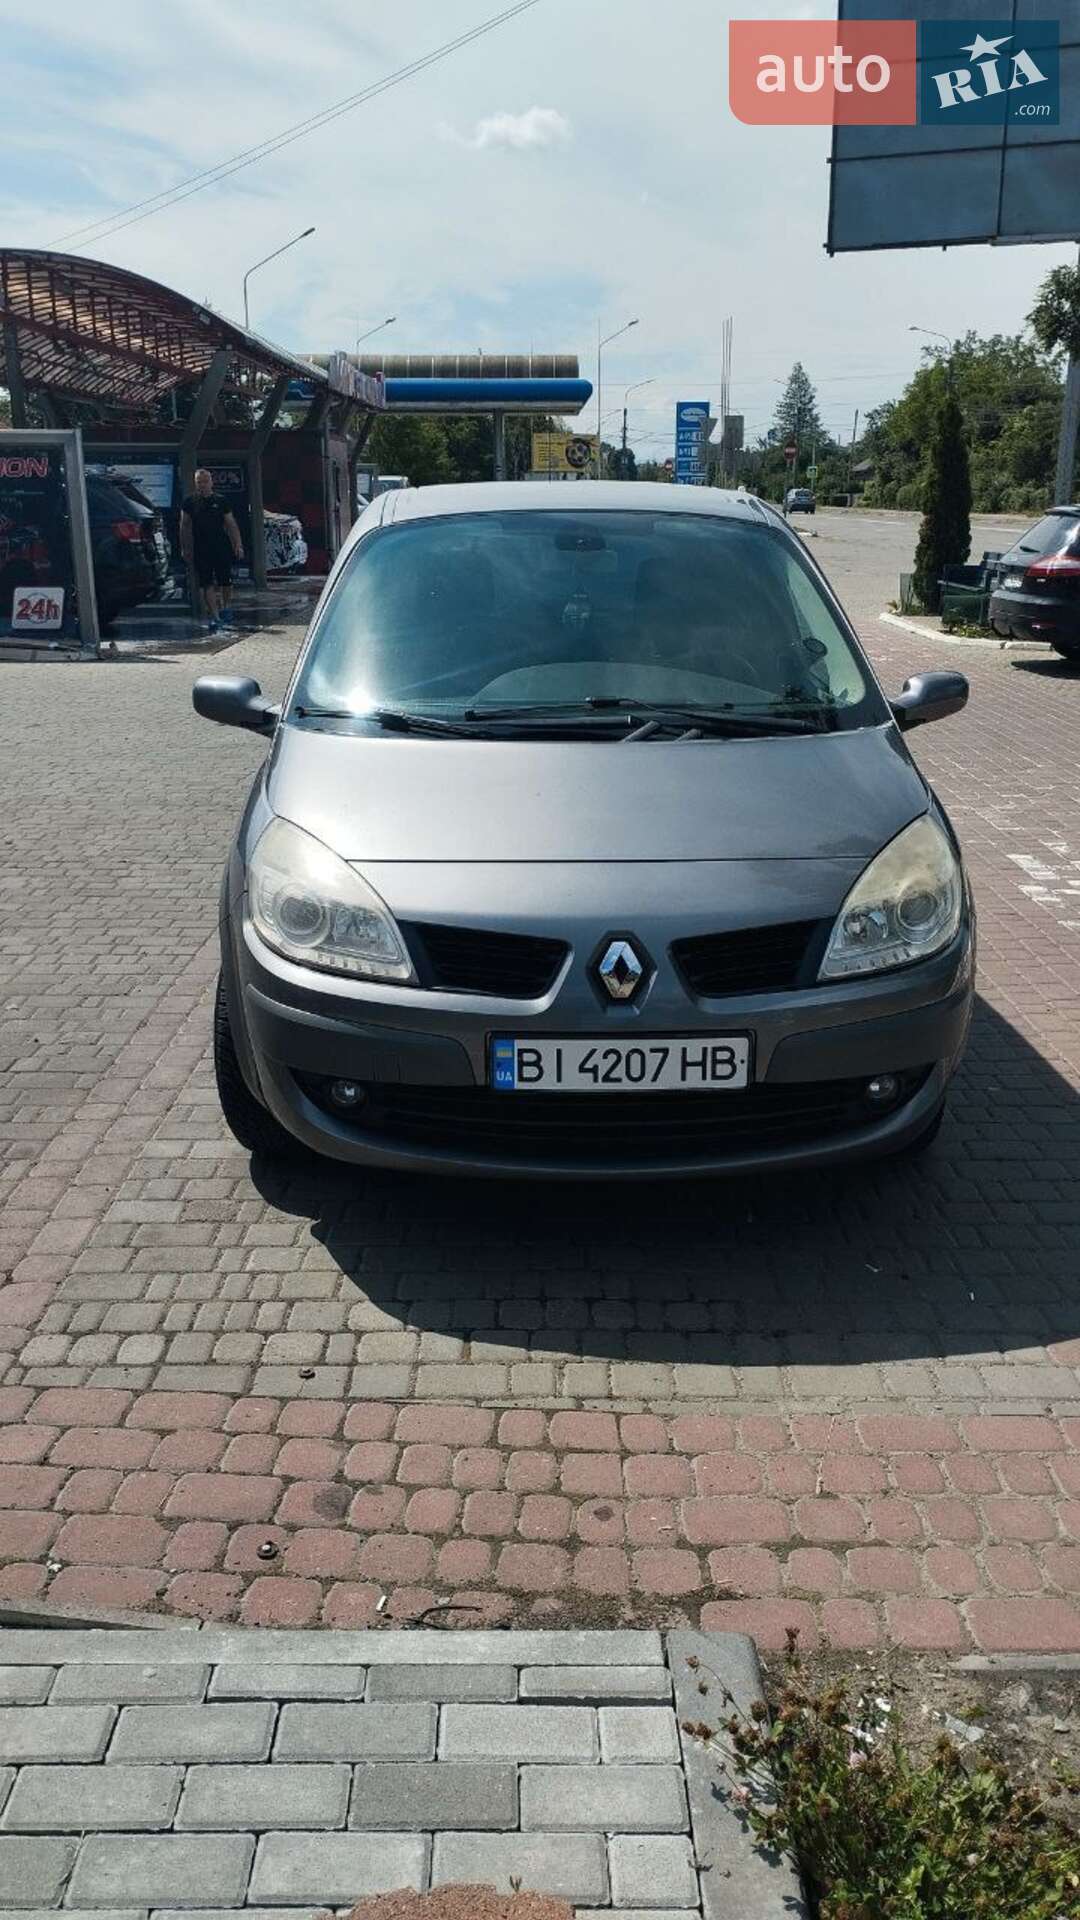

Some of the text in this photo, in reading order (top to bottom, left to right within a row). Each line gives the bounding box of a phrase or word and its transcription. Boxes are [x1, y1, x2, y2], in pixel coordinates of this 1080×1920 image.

[16, 598, 60, 620] 24h
[578, 1047, 670, 1083] 4207
[681, 1046, 738, 1082] HB
[496, 1070, 513, 1082] UA
